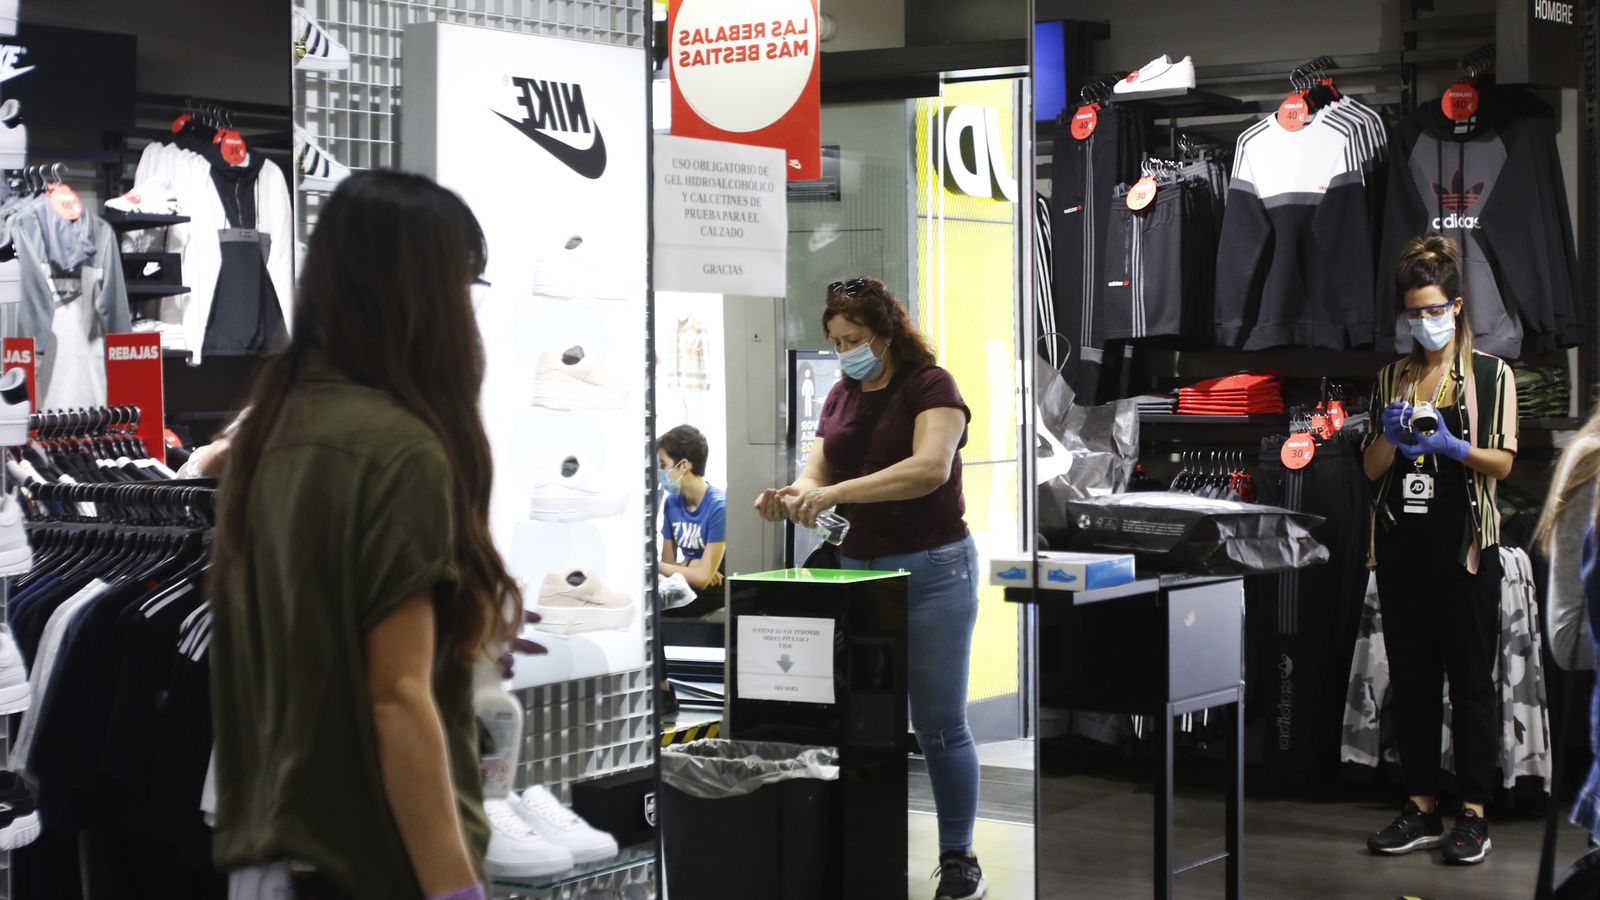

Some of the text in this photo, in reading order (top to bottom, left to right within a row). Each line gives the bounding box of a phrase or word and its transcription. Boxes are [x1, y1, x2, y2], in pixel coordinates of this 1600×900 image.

[1534, 0, 1573, 24] HOMBRE
[672, 158, 769, 176] USO OBLIGATORIO DE
[664, 174, 683, 186] GEL
[682, 192, 762, 207] Y CALCETINES DE
[684, 208, 759, 223] PRUEBA PARA EL
[700, 225, 744, 238] CALZADO
[702, 264, 743, 275] GRACIAS
[4, 350, 32, 364] JAS
[108, 345, 159, 361] REBAJAS
[1411, 483, 1424, 491] JD
[1277, 680, 1292, 751] adidas
